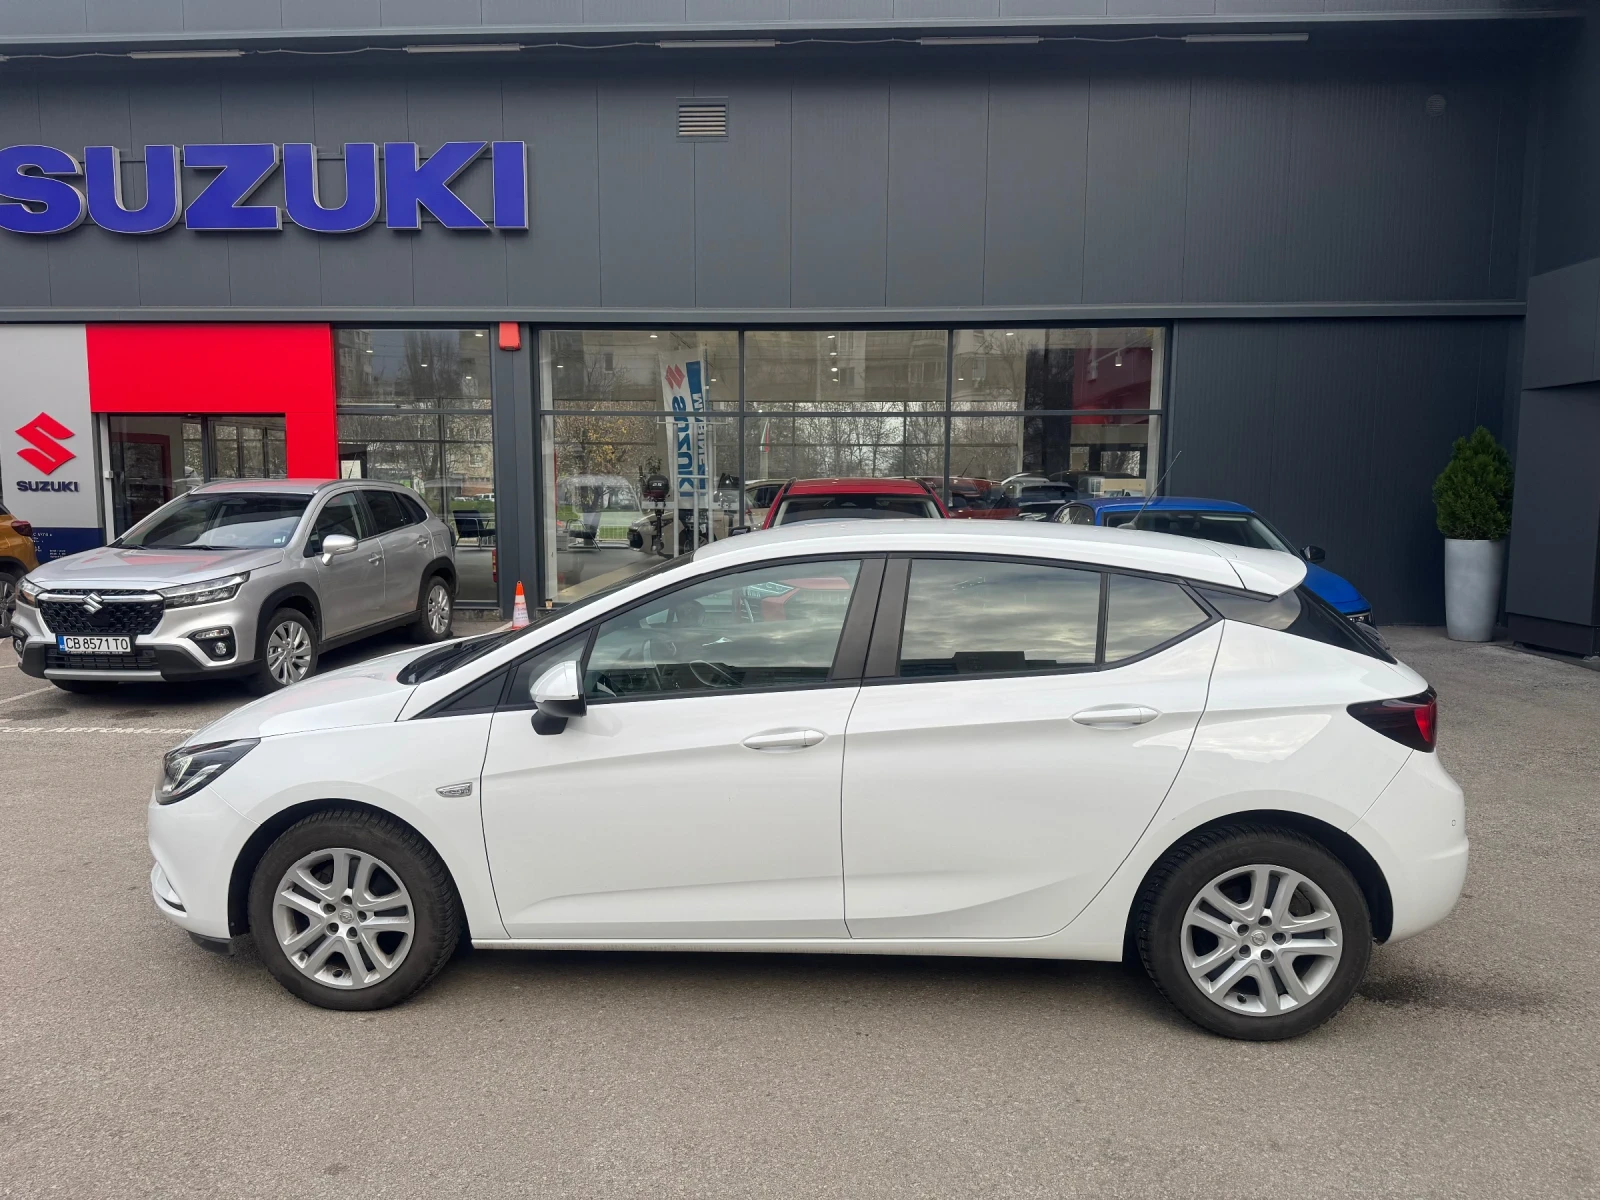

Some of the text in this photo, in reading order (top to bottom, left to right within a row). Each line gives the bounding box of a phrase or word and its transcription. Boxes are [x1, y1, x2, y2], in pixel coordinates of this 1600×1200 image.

[0, 141, 529, 234] SUZUKI
[16, 480, 80, 493] SUZUKI
[65, 637, 129, 650] CB 8571 TO
